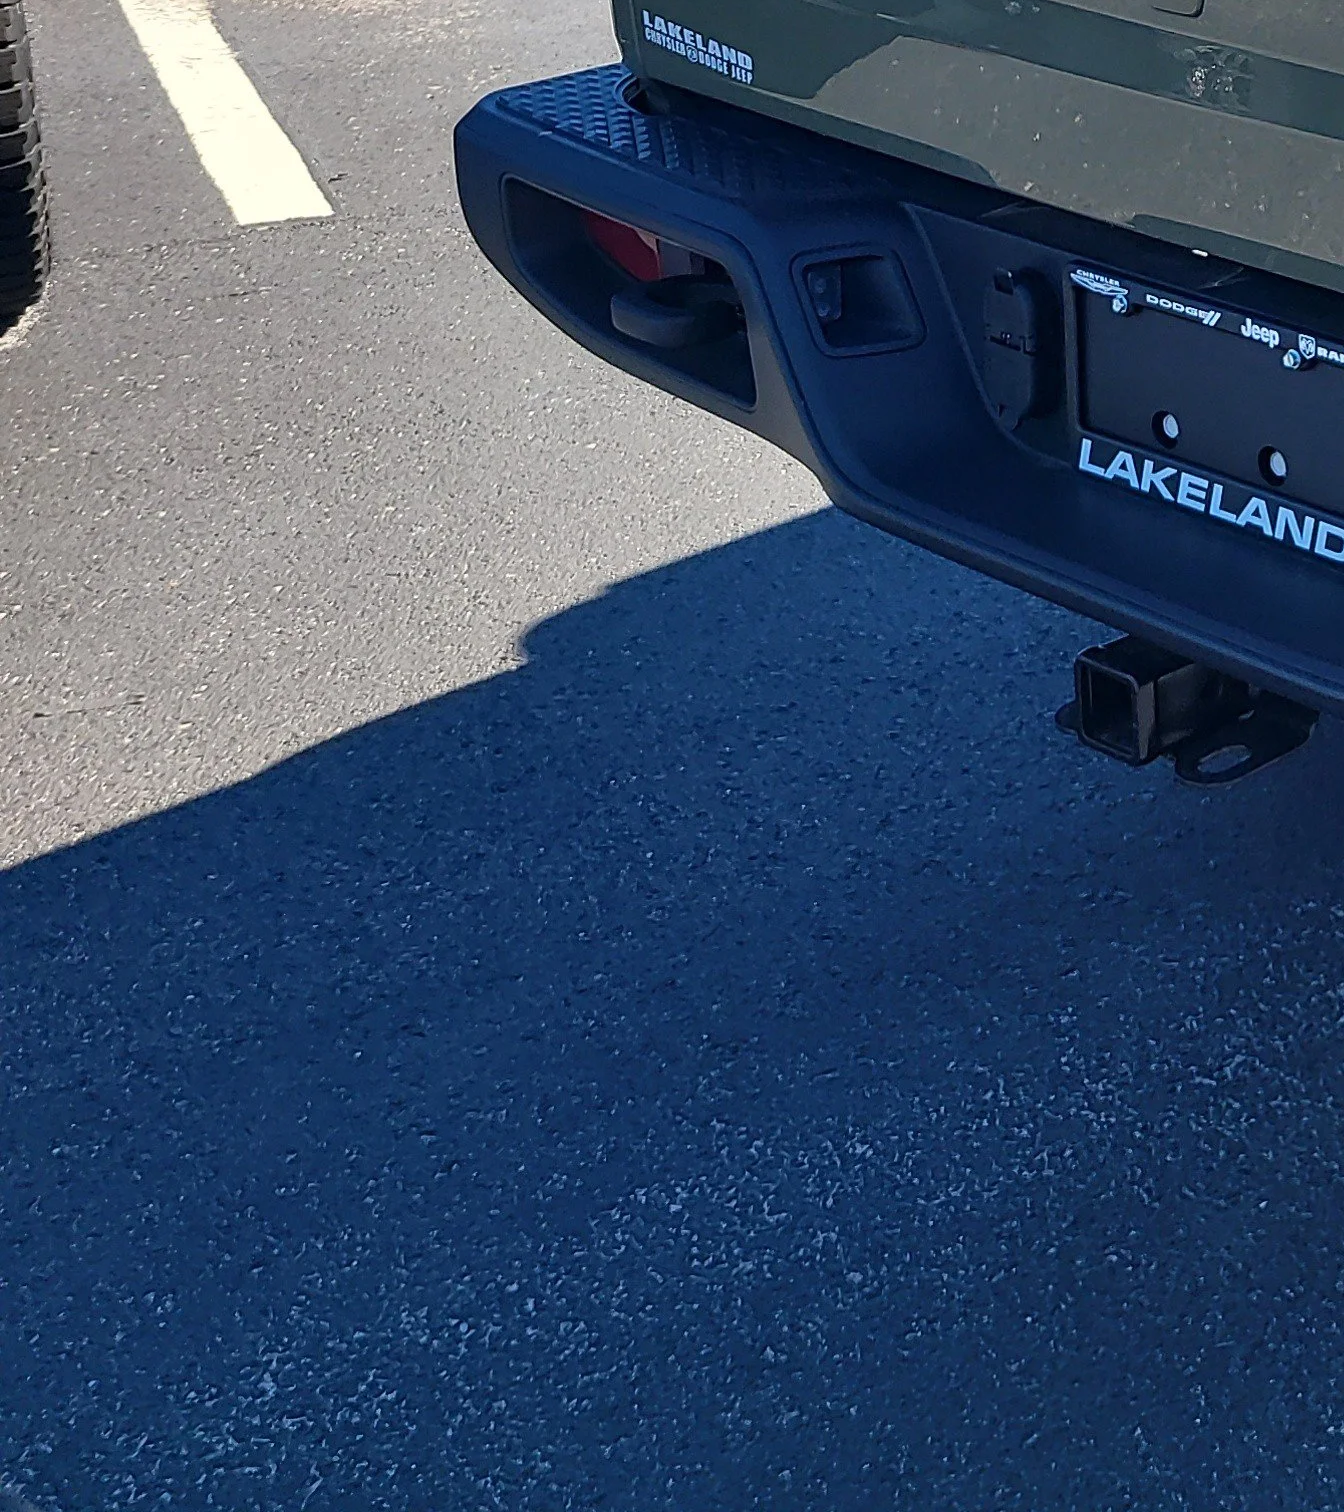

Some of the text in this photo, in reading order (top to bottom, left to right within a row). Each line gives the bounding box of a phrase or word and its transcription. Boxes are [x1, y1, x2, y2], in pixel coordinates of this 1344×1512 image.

[642, 9, 753, 71] LAKELAND
[644, 27, 753, 85] CHRYSLER DODGE JEEP
[1075, 268, 1121, 288] CHRYSLER
[1145, 293, 1209, 320] DODGE
[1240, 317, 1280, 349] Jeep
